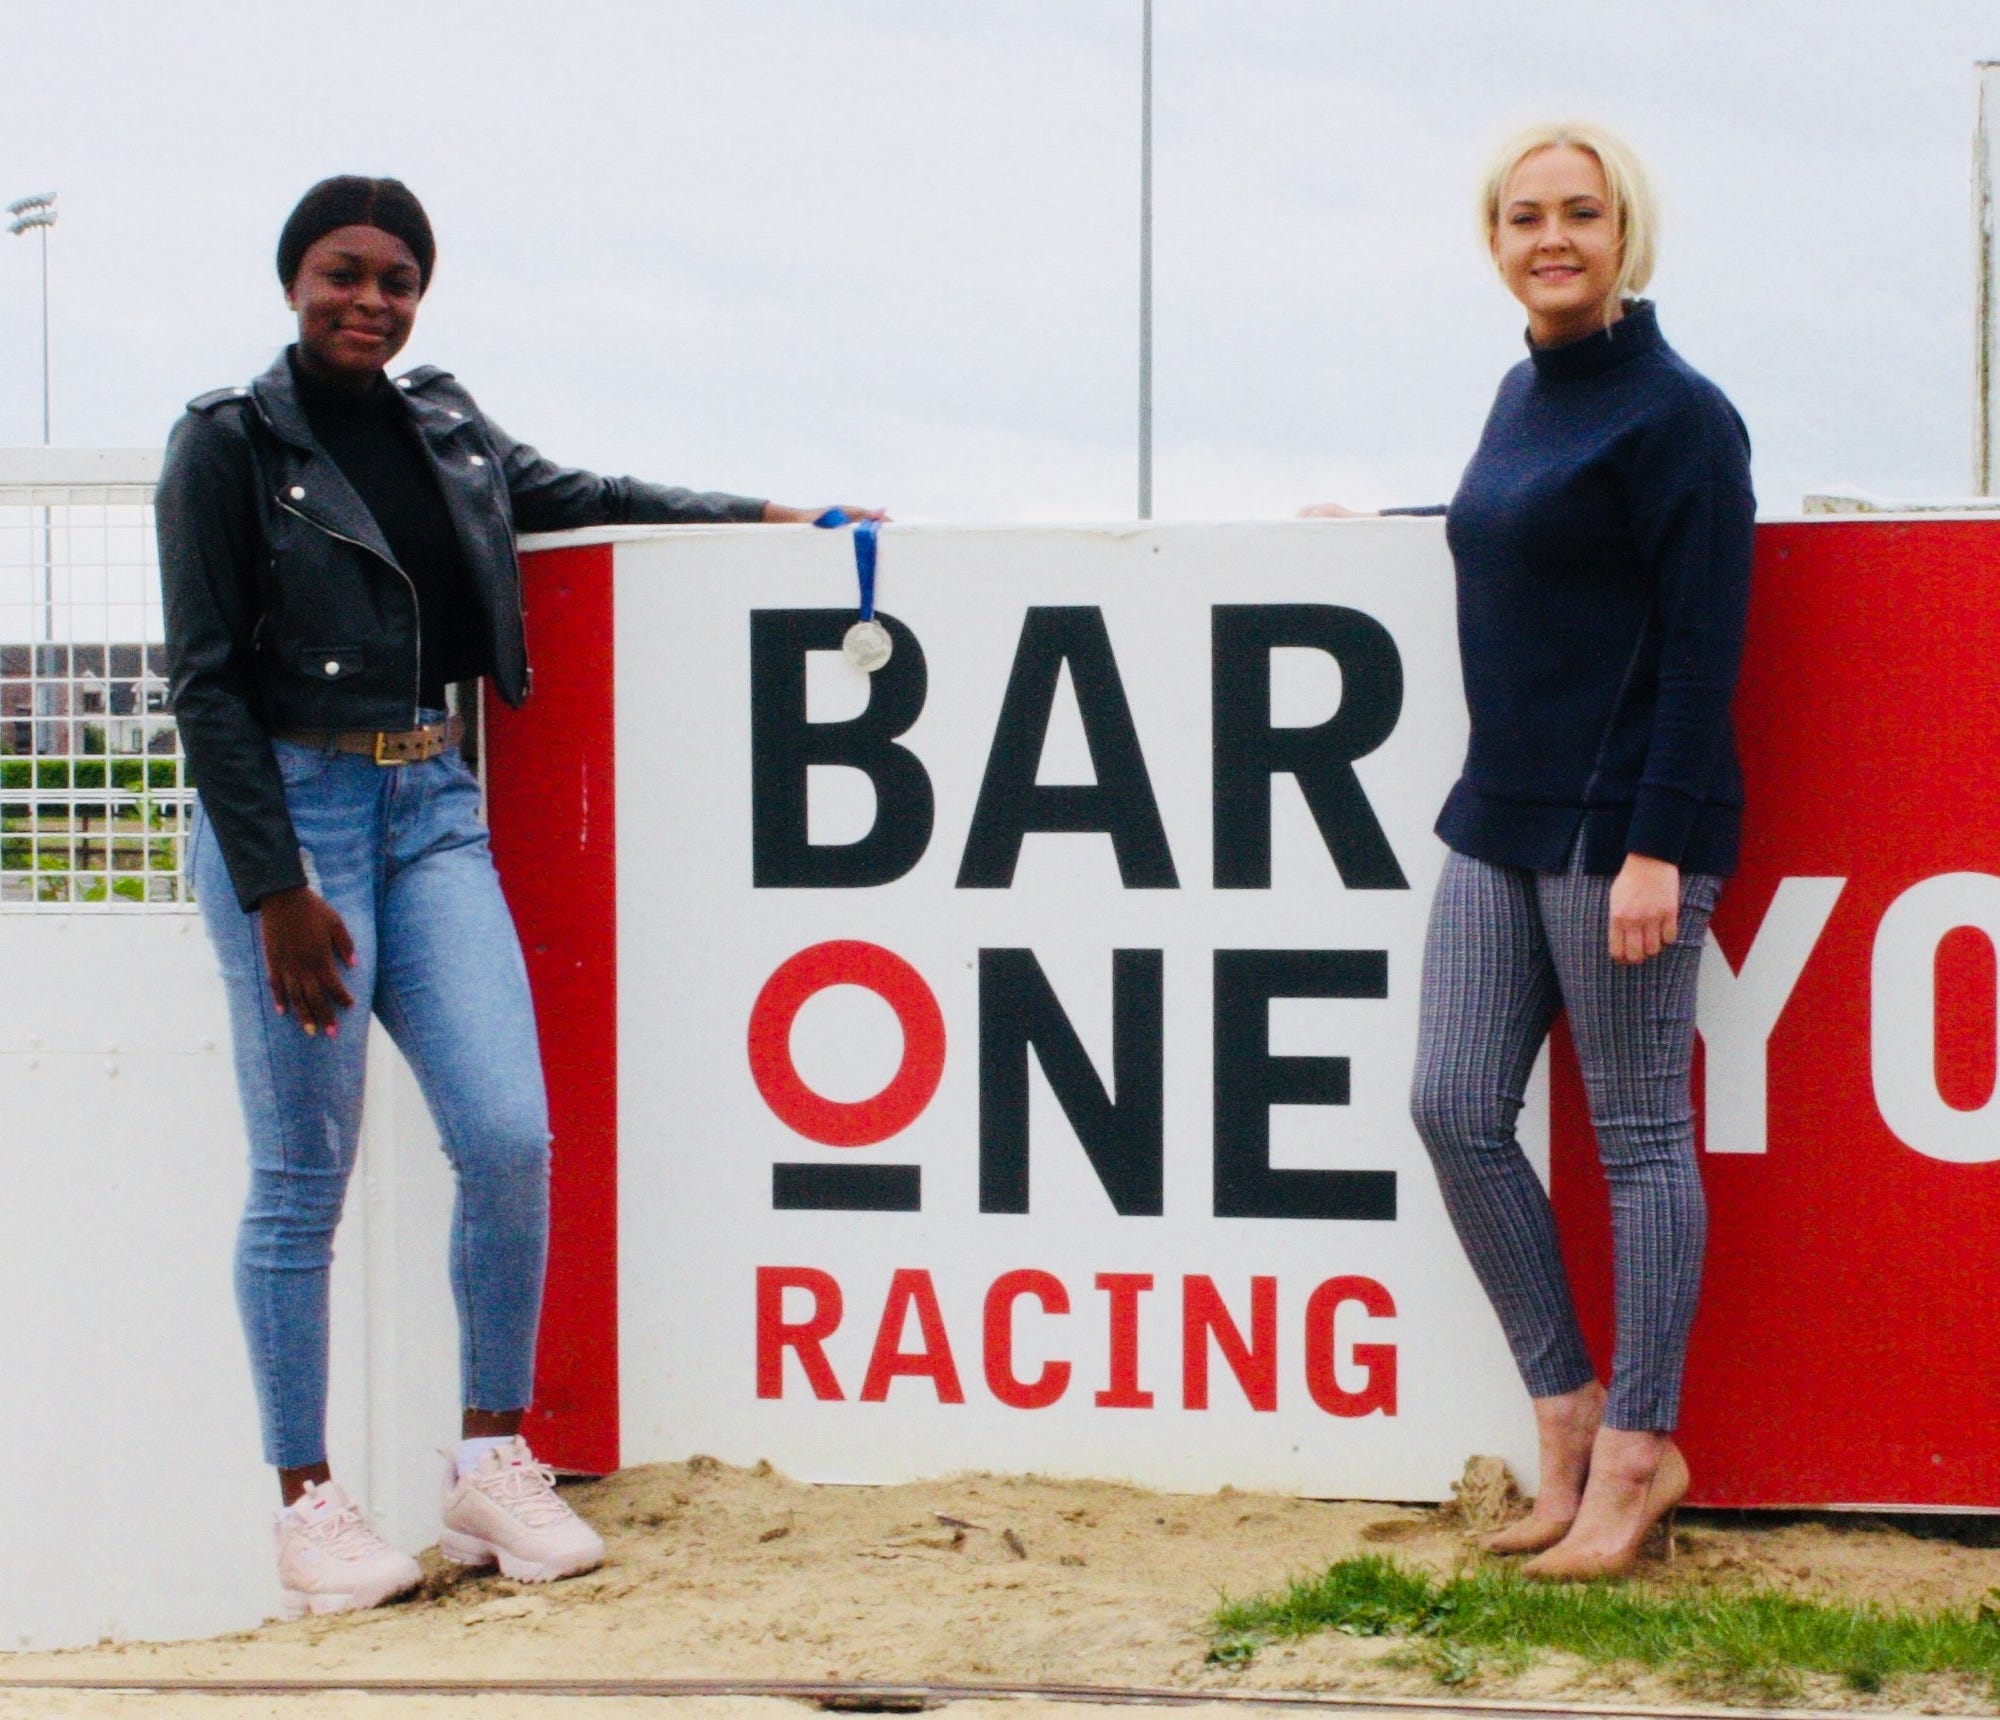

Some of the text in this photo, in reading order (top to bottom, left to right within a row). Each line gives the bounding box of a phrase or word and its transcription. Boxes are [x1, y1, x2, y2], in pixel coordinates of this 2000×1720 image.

[750, 603, 1410, 890] BAR
[748, 940, 1397, 1221] ONE
[756, 1266, 1397, 1418] RACING
